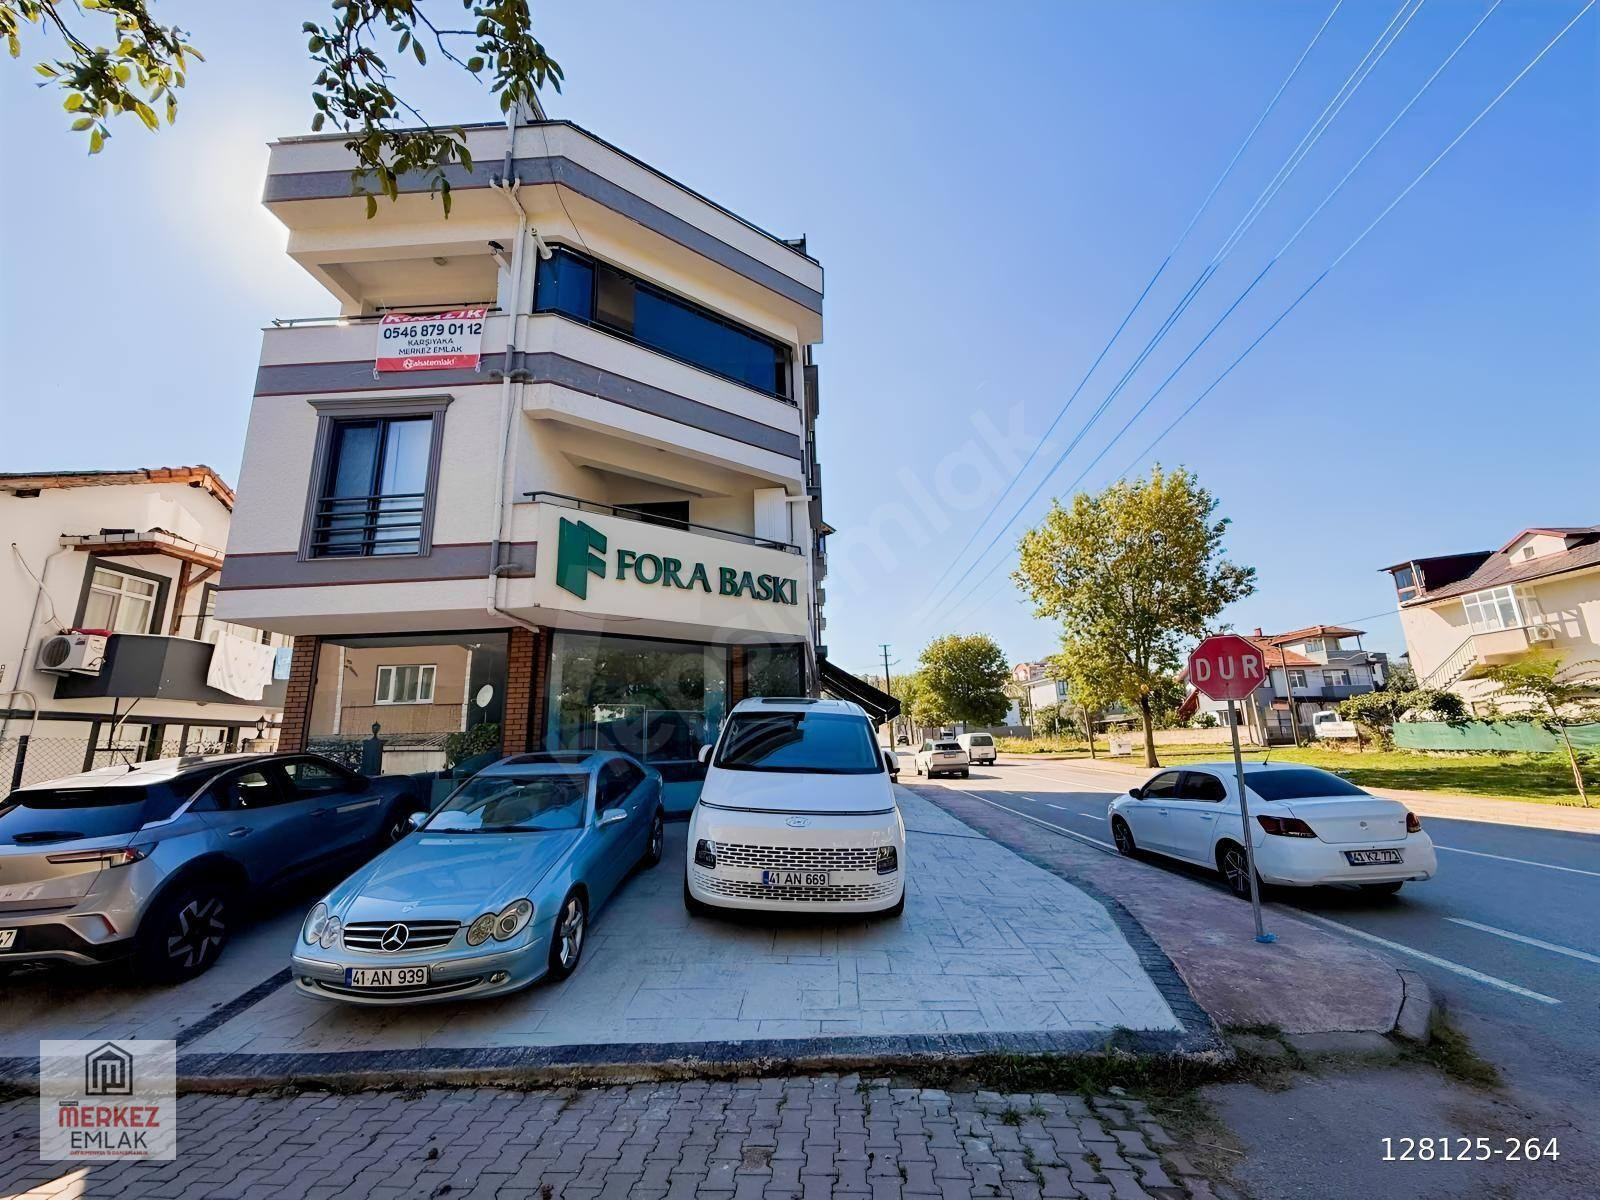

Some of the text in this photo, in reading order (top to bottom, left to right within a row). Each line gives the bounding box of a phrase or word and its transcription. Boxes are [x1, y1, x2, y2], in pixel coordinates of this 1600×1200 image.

[384, 326, 417, 339] 0546
[421, 324, 444, 337] 879
[399, 346, 431, 355] MERKEZ
[616, 548, 798, 605] FORA BASKI
[1195, 654, 1260, 682] DUR
[768, 872, 826, 886] 41 AN 669
[352, 968, 425, 986] 41 AN 939
